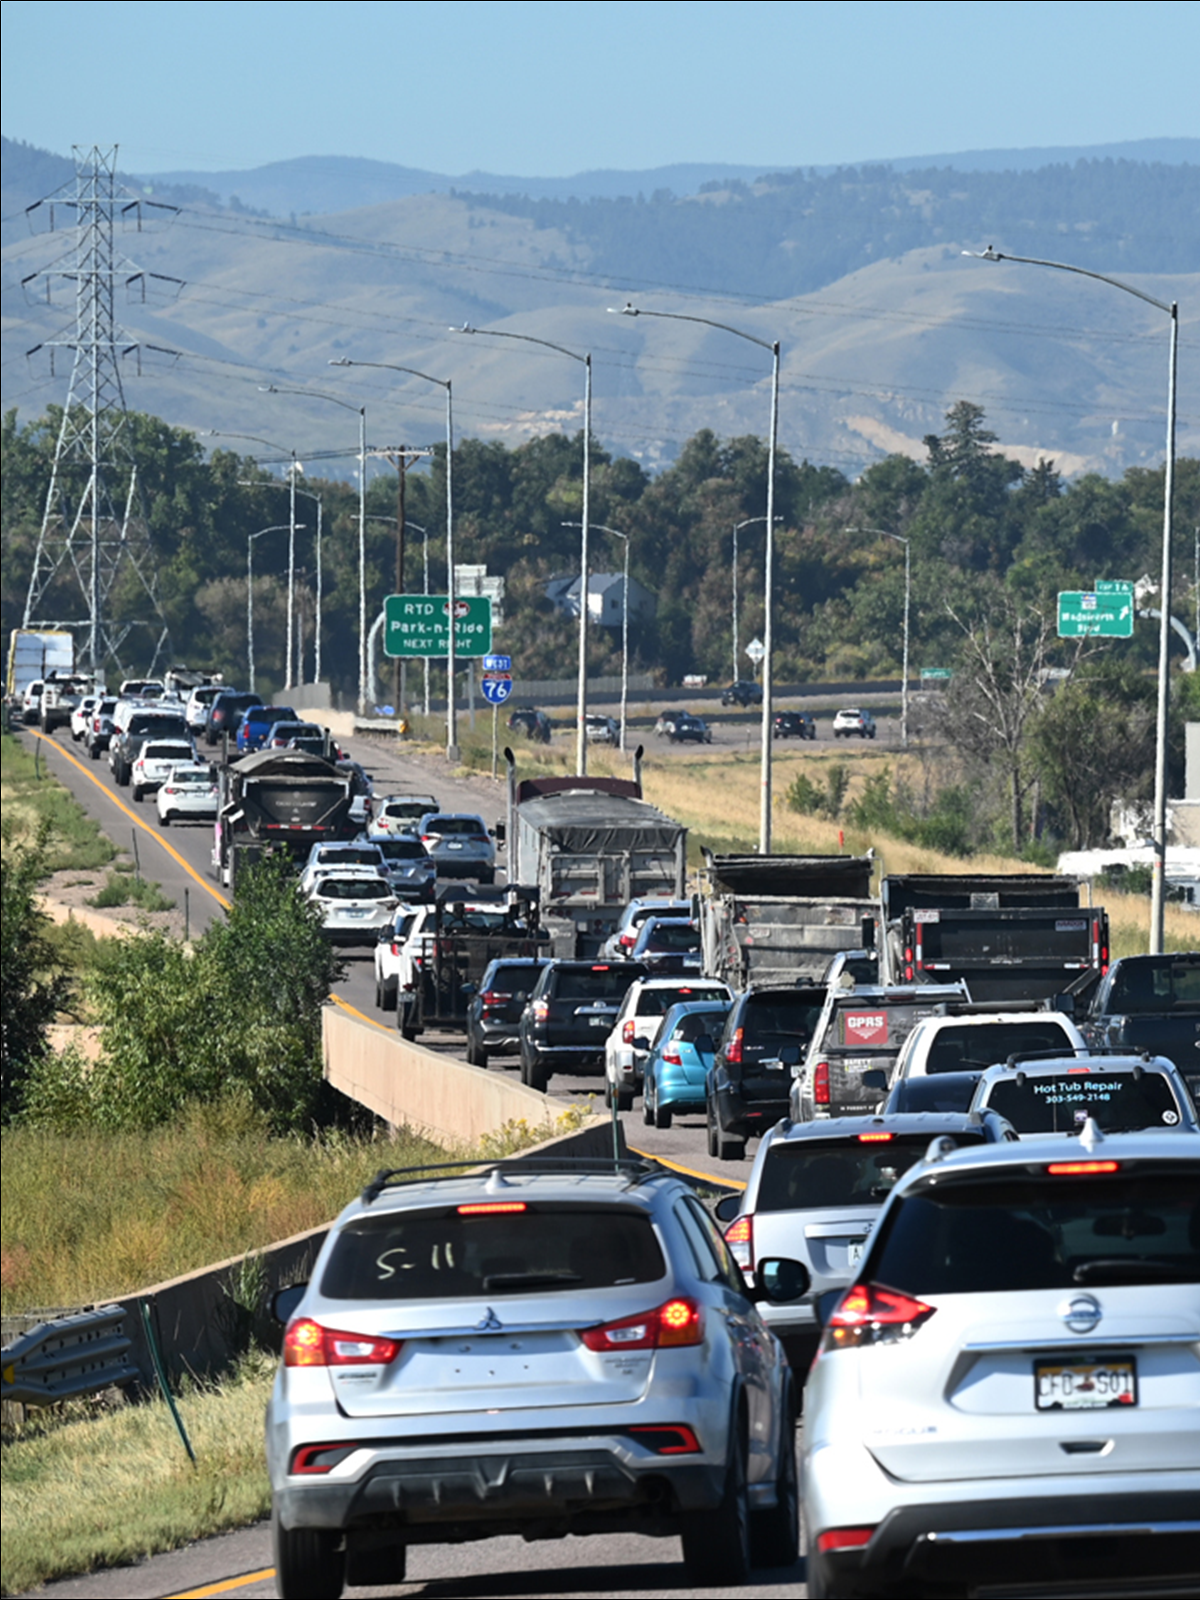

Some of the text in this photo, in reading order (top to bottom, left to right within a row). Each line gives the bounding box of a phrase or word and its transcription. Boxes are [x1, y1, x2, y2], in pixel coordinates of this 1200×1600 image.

[404, 603, 434, 615] RTD
[391, 621, 485, 634] Park-n-Ride
[403, 638, 472, 649] NEXT RIHT
[486, 683, 507, 698] 76
[847, 1016, 884, 1028] GPRS
[1034, 1082, 1122, 1094] Hot Tub Repair
[1045, 1093, 1111, 1104] 303-549-2148
